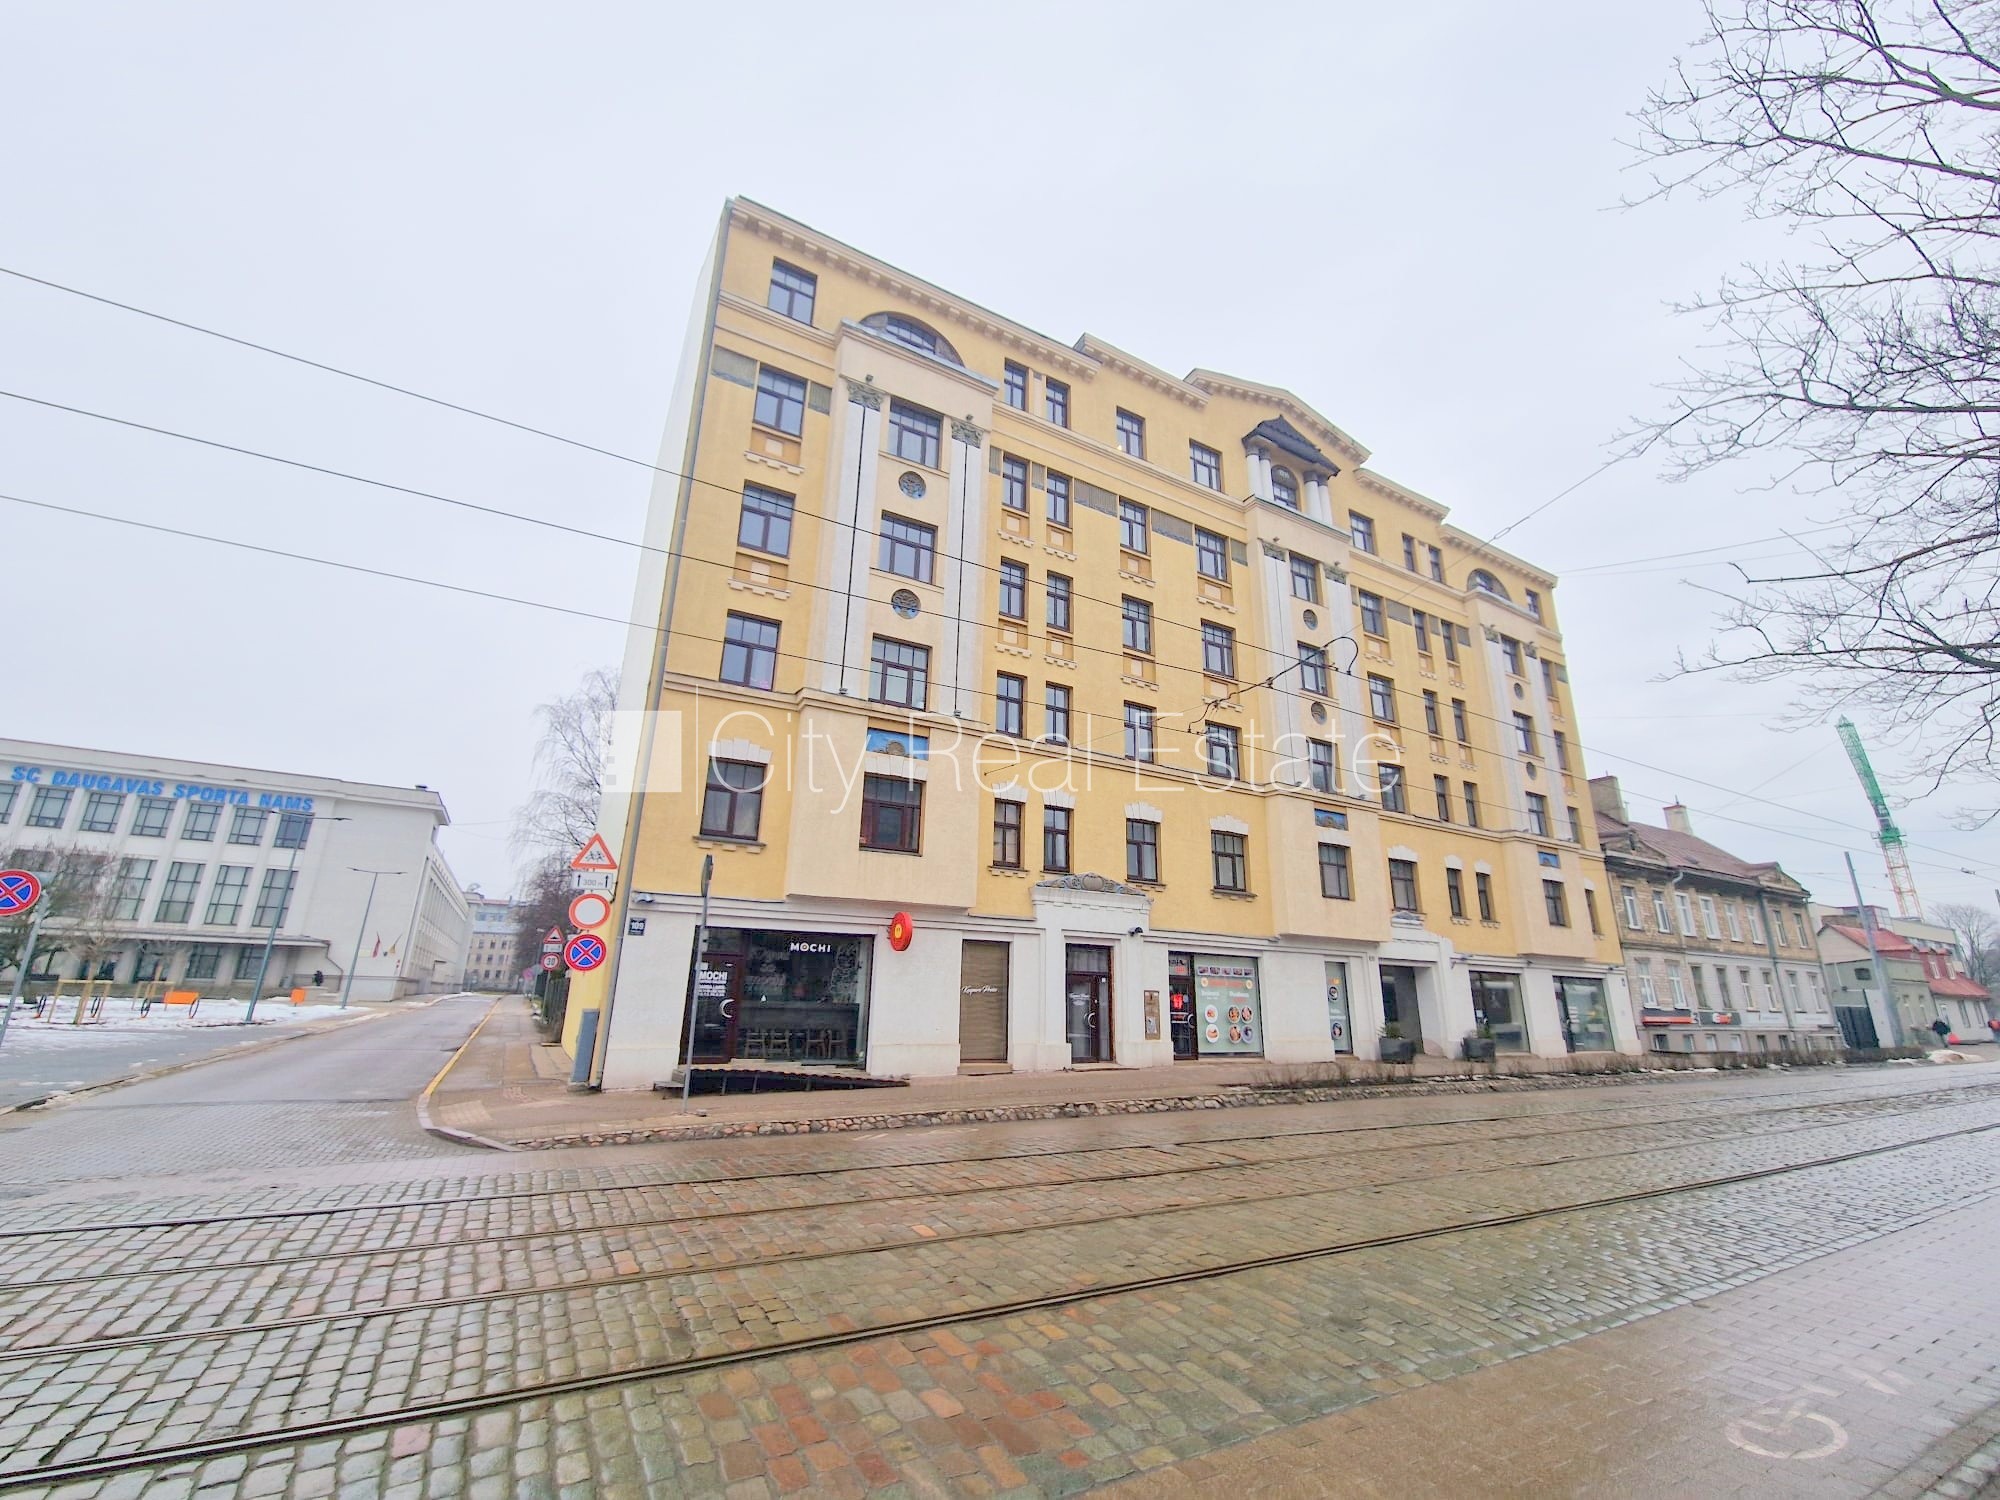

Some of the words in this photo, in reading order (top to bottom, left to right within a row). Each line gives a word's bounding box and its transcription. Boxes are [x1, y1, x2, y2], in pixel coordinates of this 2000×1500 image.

[11, 766, 41, 783] SC
[52, 770, 165, 796] DAUGAVAS
[173, 783, 249, 806] SPORTA
[259, 792, 314, 812] NAMS
[631, 921, 644, 930] 109
[790, 943, 831, 952] MOCHI
[546, 957, 556, 966] 30
[700, 971, 727, 980] MOCHI
